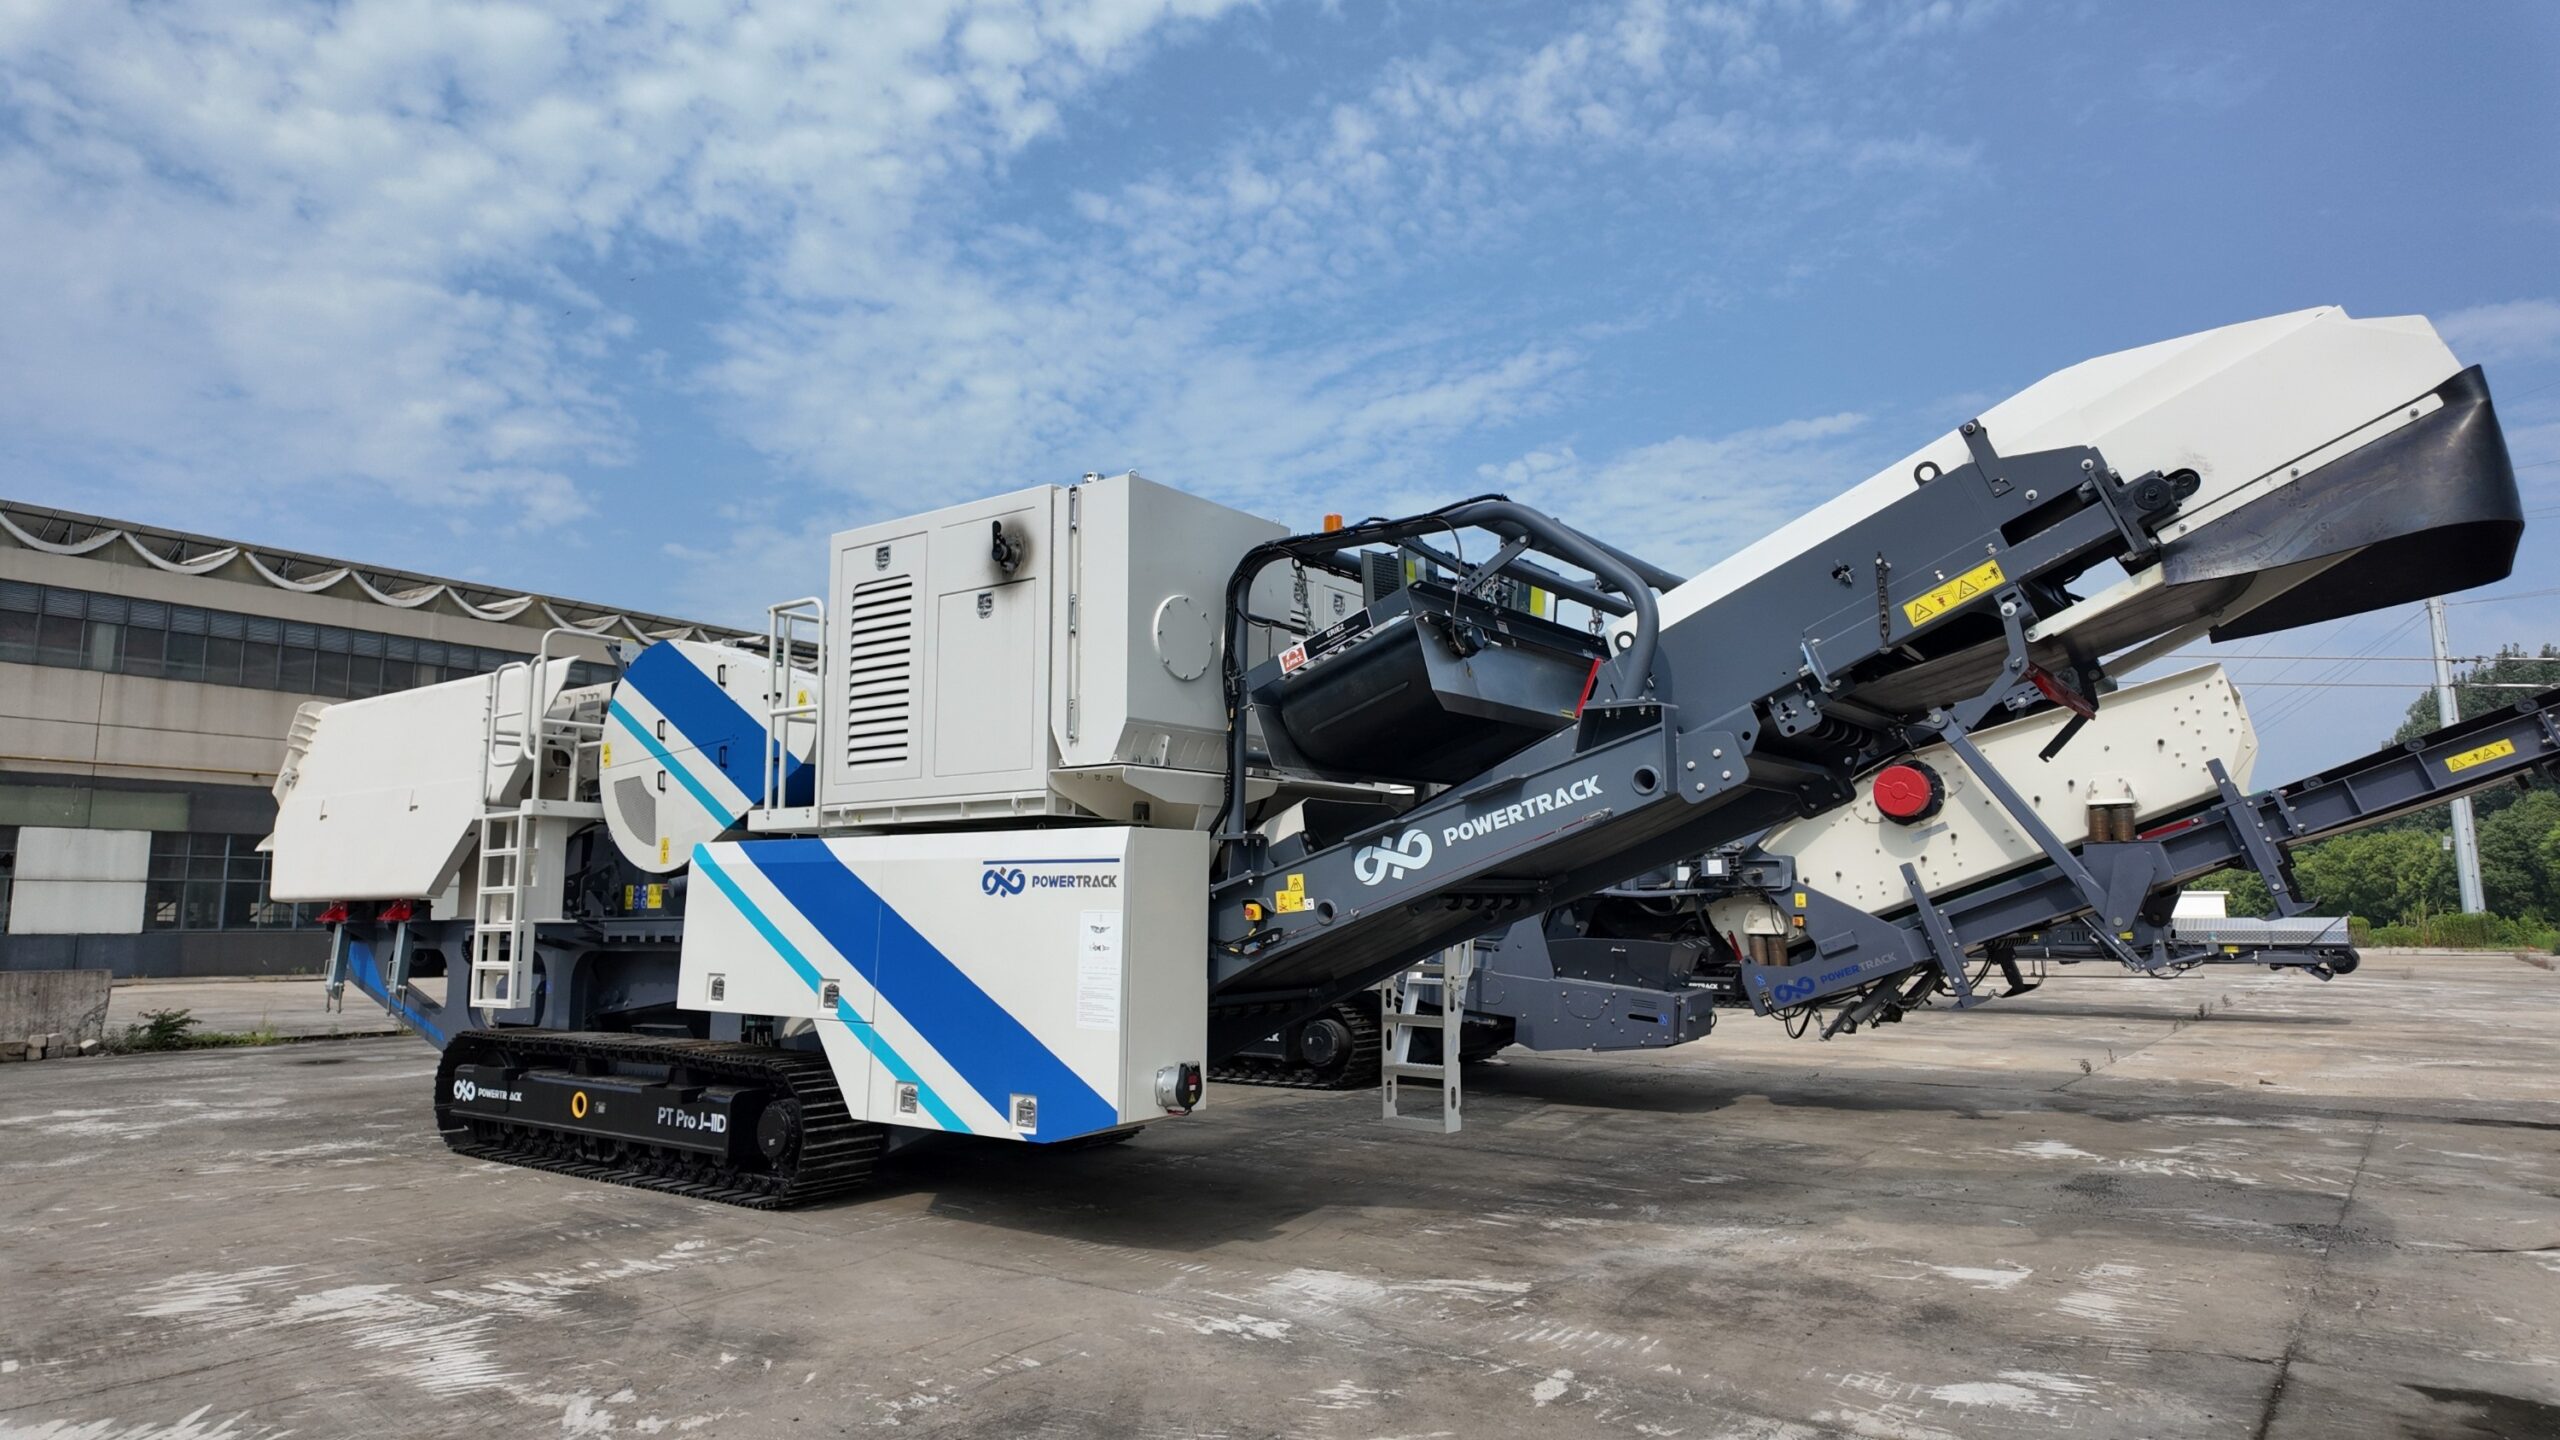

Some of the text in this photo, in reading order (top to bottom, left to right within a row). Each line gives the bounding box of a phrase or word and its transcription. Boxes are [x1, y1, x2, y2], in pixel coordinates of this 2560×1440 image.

[1326, 623, 1346, 638] ERIEZ
[1443, 774, 1604, 847] POWERTRACK
[1032, 875, 1117, 888] POWERTRACK
[1820, 952, 1897, 985] POWERTRACK
[658, 1106, 674, 1126] PT
[676, 1109, 696, 1129] Pro
